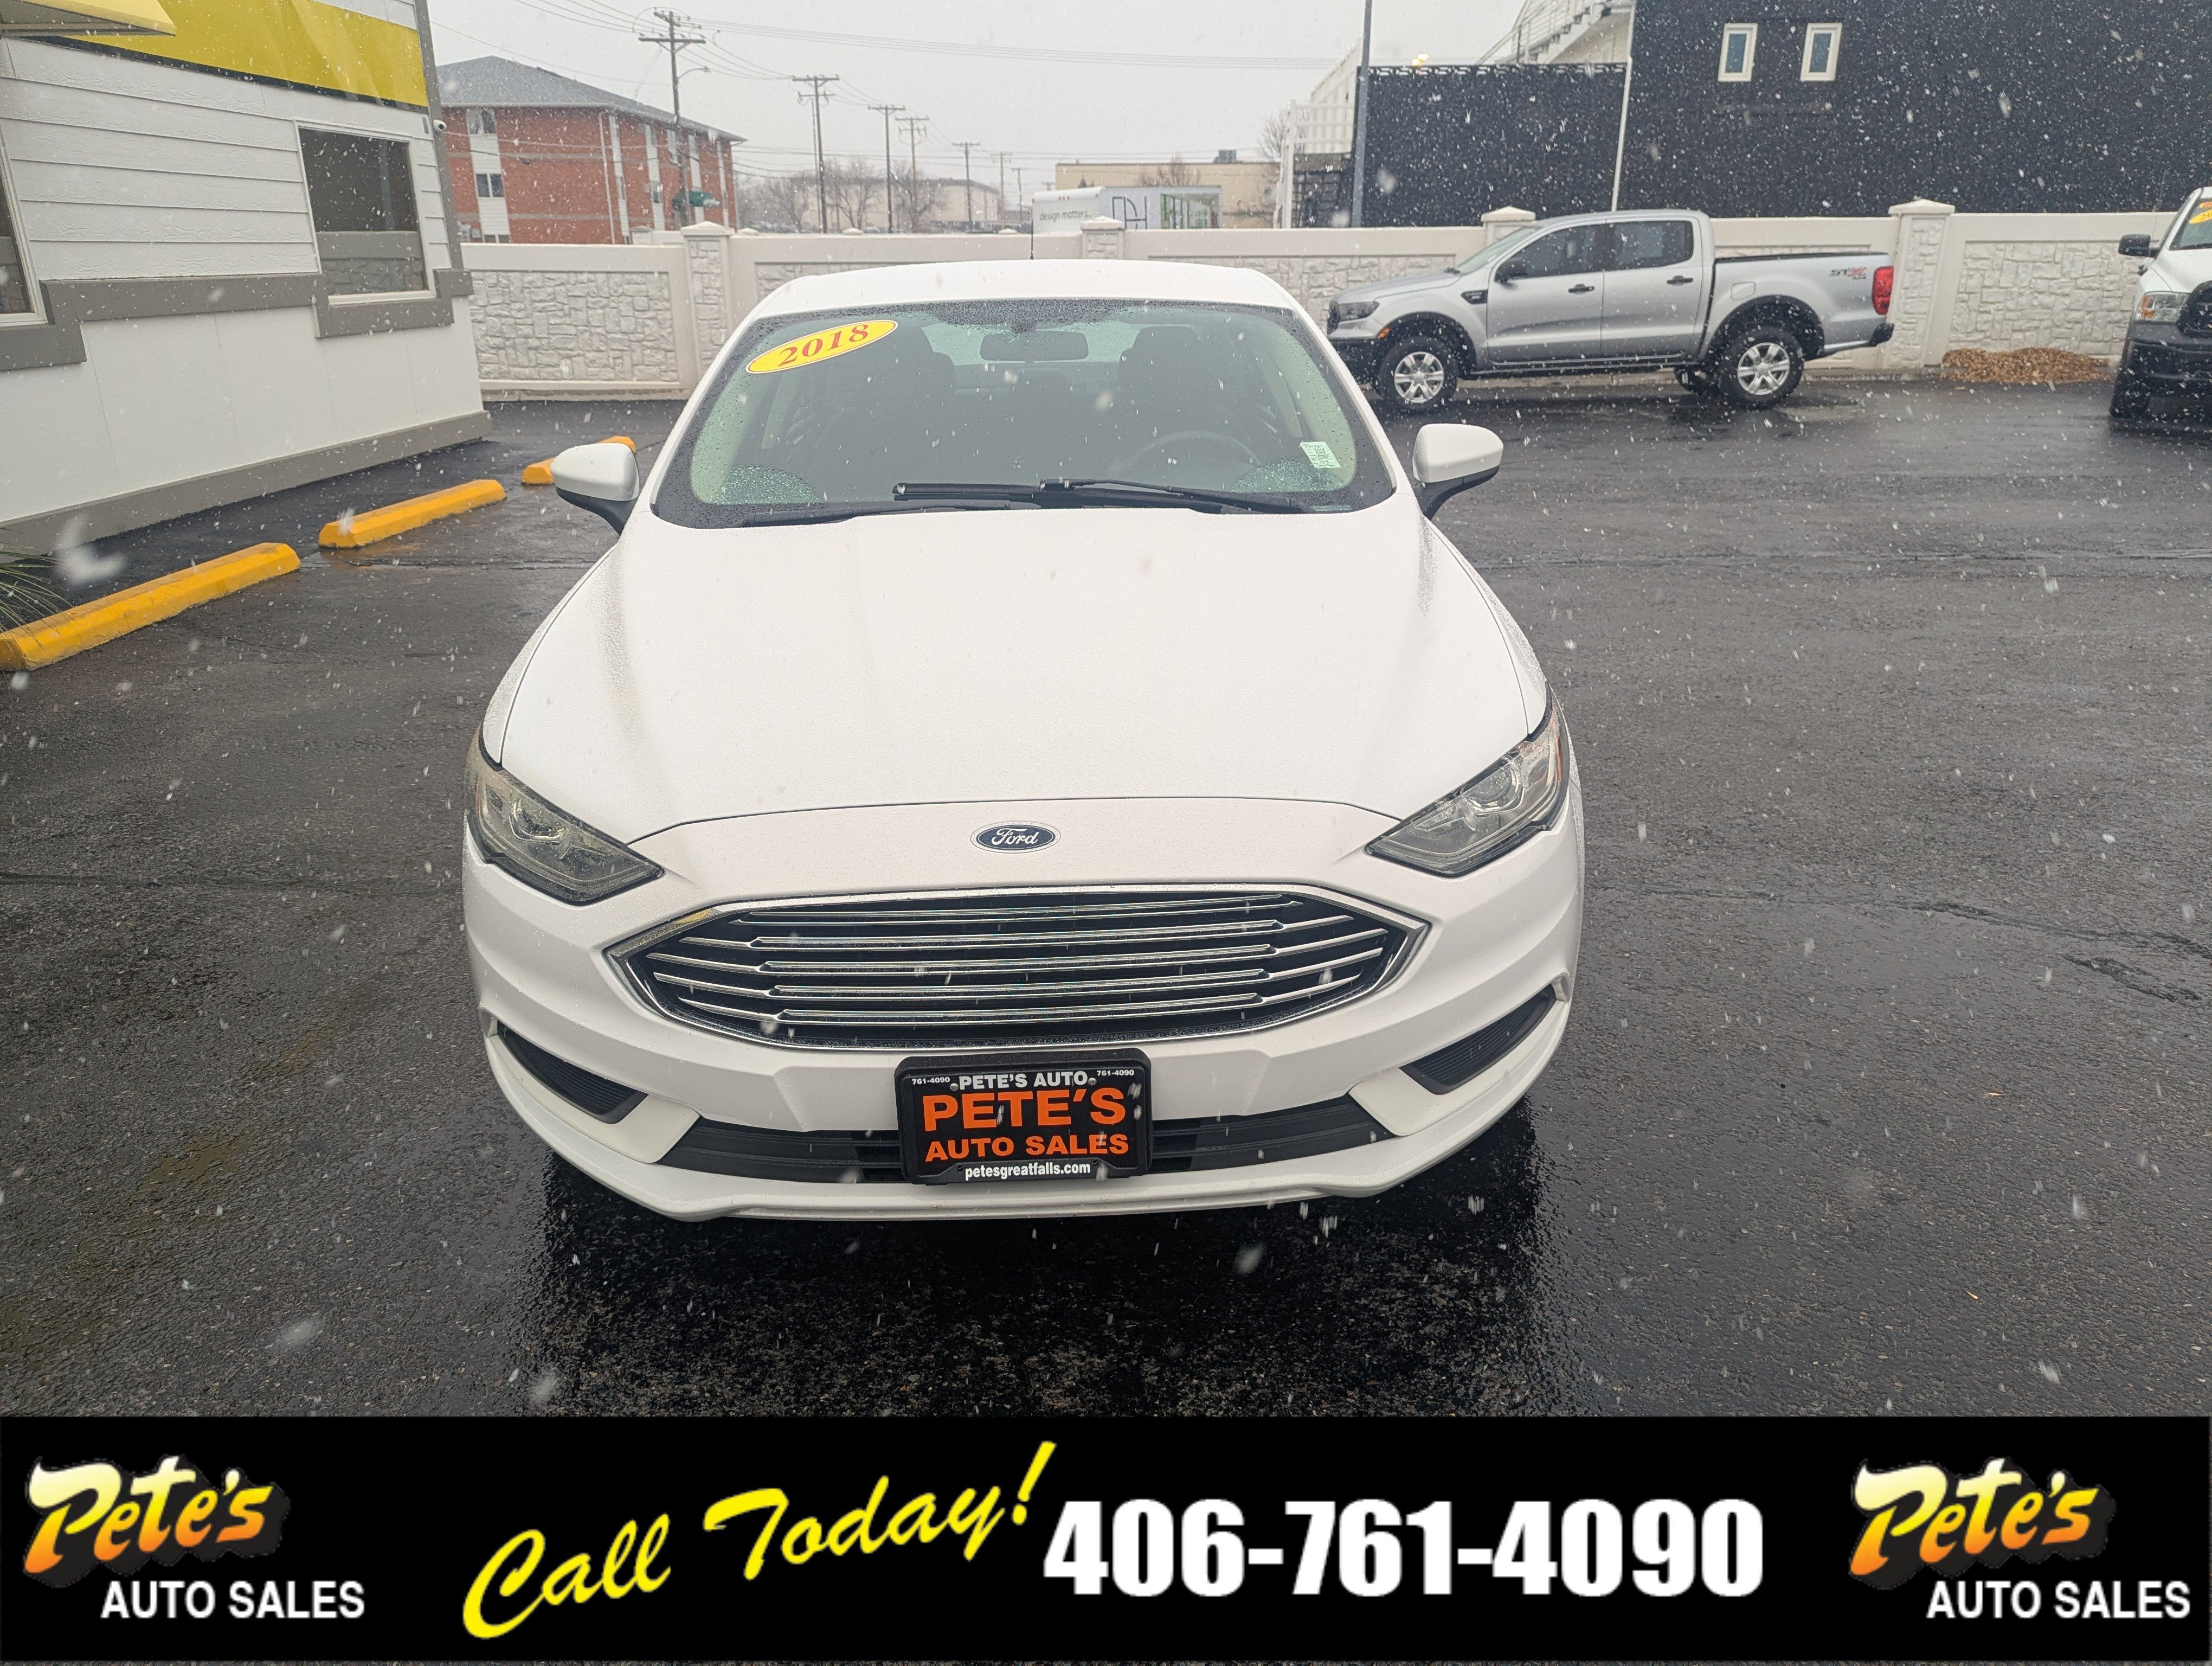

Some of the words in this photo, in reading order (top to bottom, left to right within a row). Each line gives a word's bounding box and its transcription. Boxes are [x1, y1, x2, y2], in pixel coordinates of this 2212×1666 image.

[1039, 212, 1060, 222] design
[778, 324, 868, 367] 2018
[991, 828, 1039, 845] Ford
[911, 1077, 950, 1085] 761-4090
[959, 1073, 1027, 1090] PETE'S
[1033, 1071, 1088, 1087] AUTO
[923, 1087, 1126, 1131] PETE'S
[925, 1137, 1014, 1162] AUTO
[1025, 1133, 1129, 1155] SALES
[965, 1162, 1090, 1181] petesgreatfalls.com
